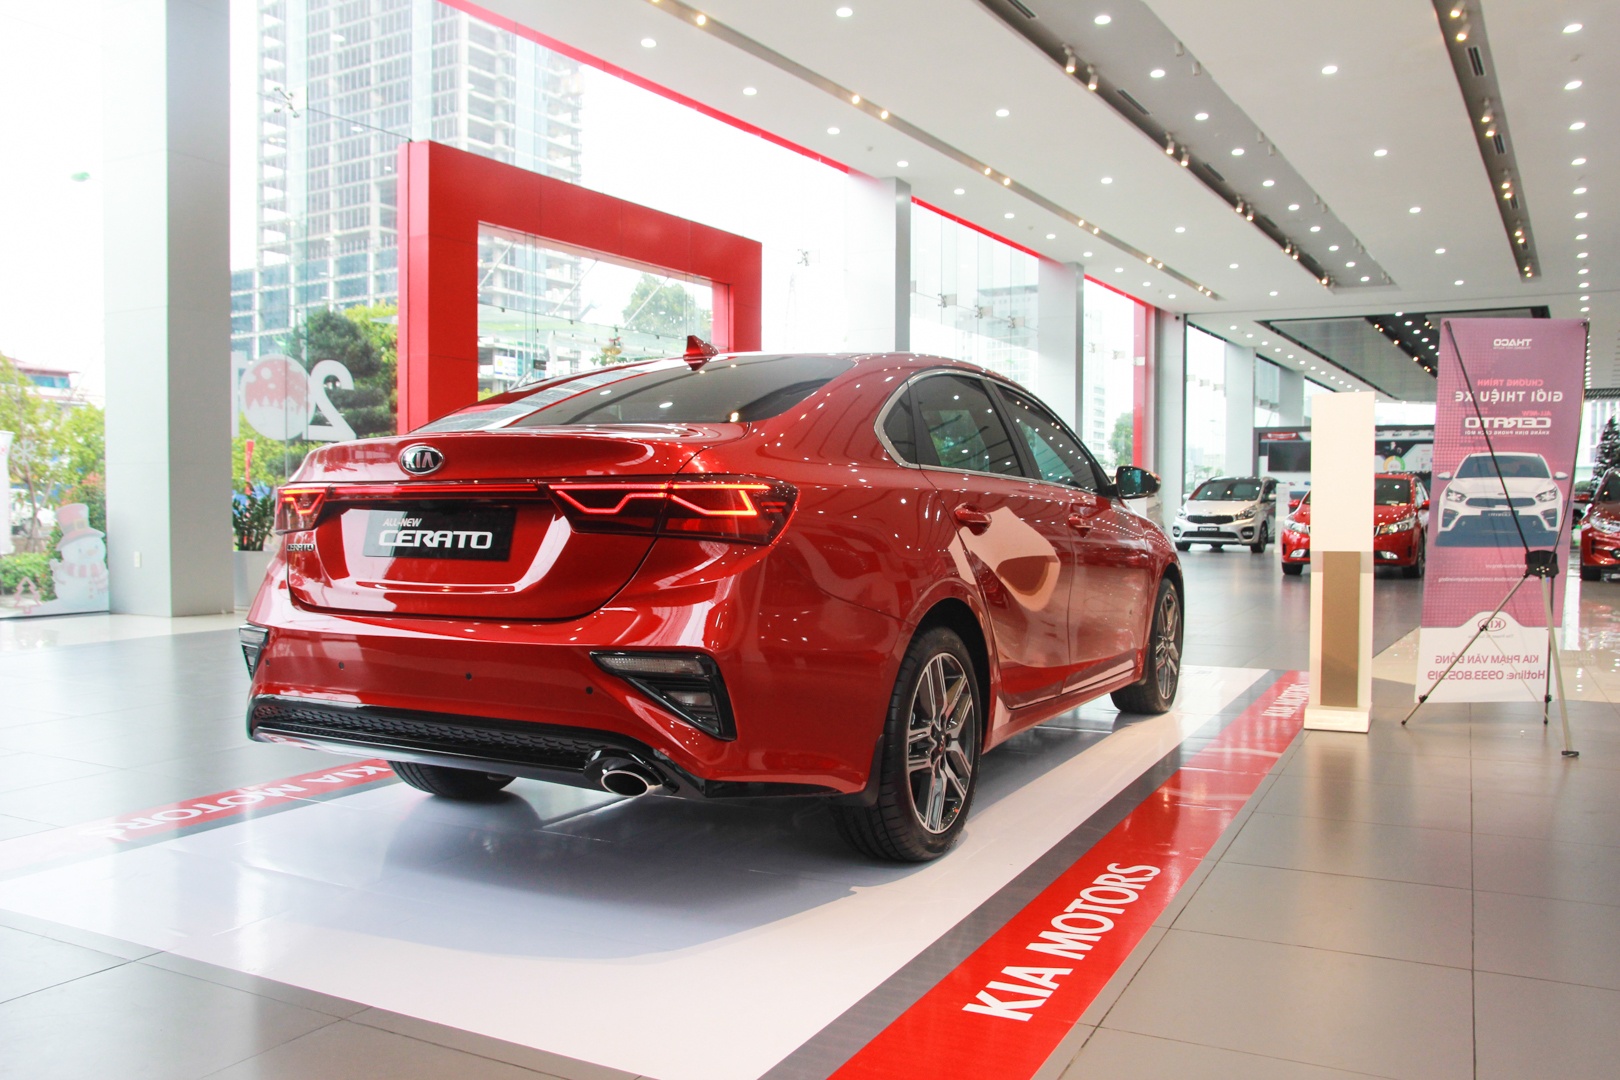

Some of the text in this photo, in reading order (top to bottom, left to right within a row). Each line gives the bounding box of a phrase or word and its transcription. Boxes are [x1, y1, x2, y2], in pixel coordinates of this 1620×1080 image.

[379, 530, 493, 549] CERATO
[382, 518, 422, 527] ALL-NEW
[77, 765, 392, 839] KIA MOTORS
[961, 862, 1161, 1022] KIA MOTORS
